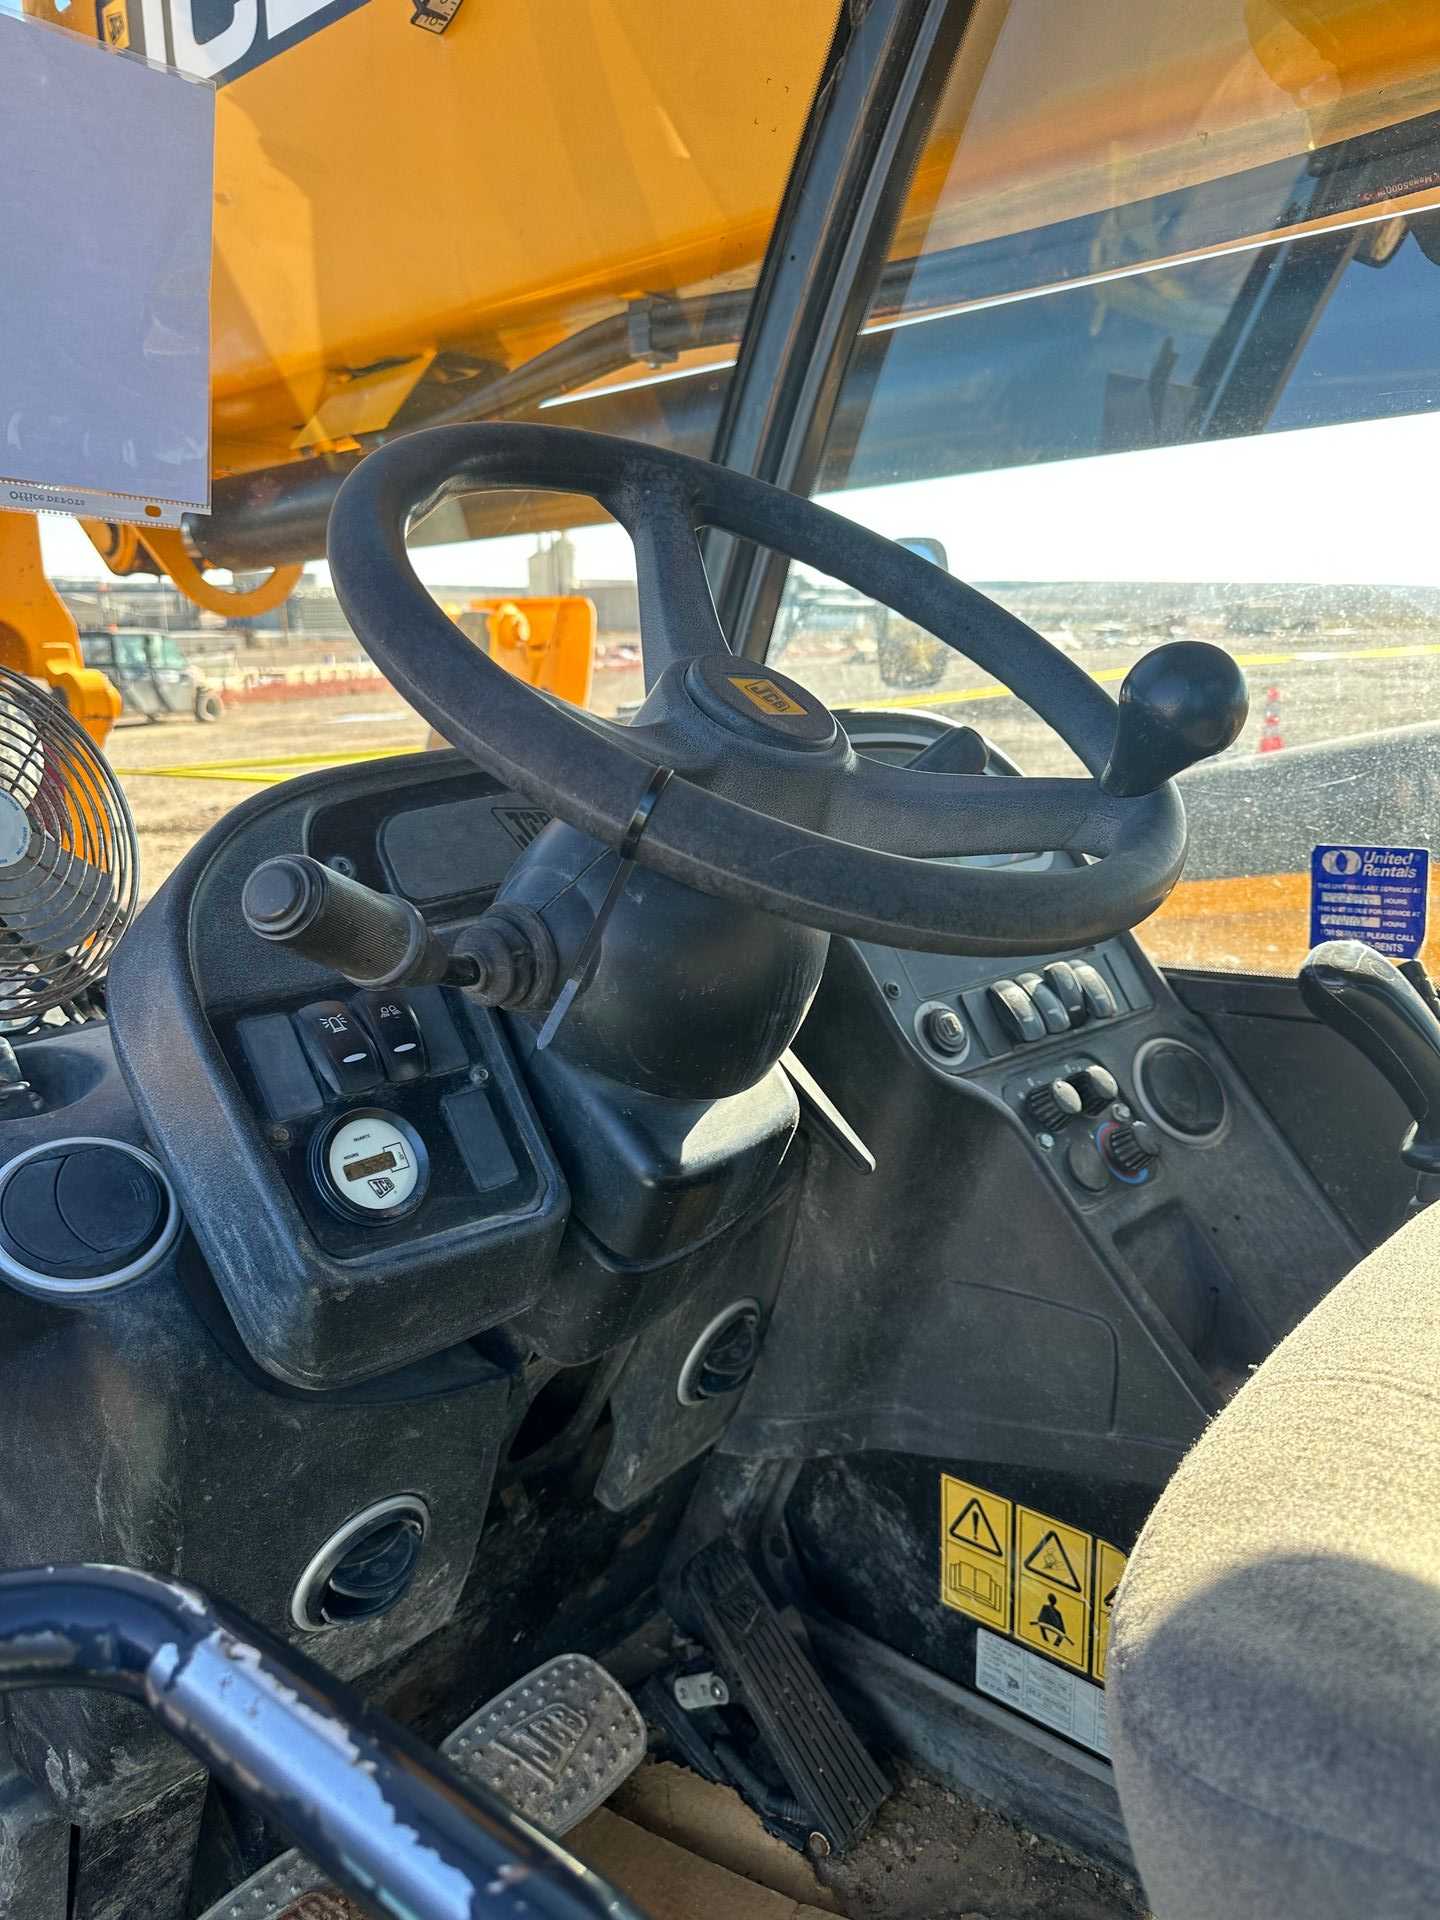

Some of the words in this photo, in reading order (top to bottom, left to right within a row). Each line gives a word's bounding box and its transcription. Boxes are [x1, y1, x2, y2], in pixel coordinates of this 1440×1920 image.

[748, 684, 789, 711] JCB
[1363, 850, 1414, 865] United
[1362, 864, 1417, 879] Rentals
[1366, 932, 1395, 941] PLEASE
[1395, 934, 1415, 942] CALL
[372, 1179, 394, 1196] JCB
[506, 1708, 585, 1775] JCB
